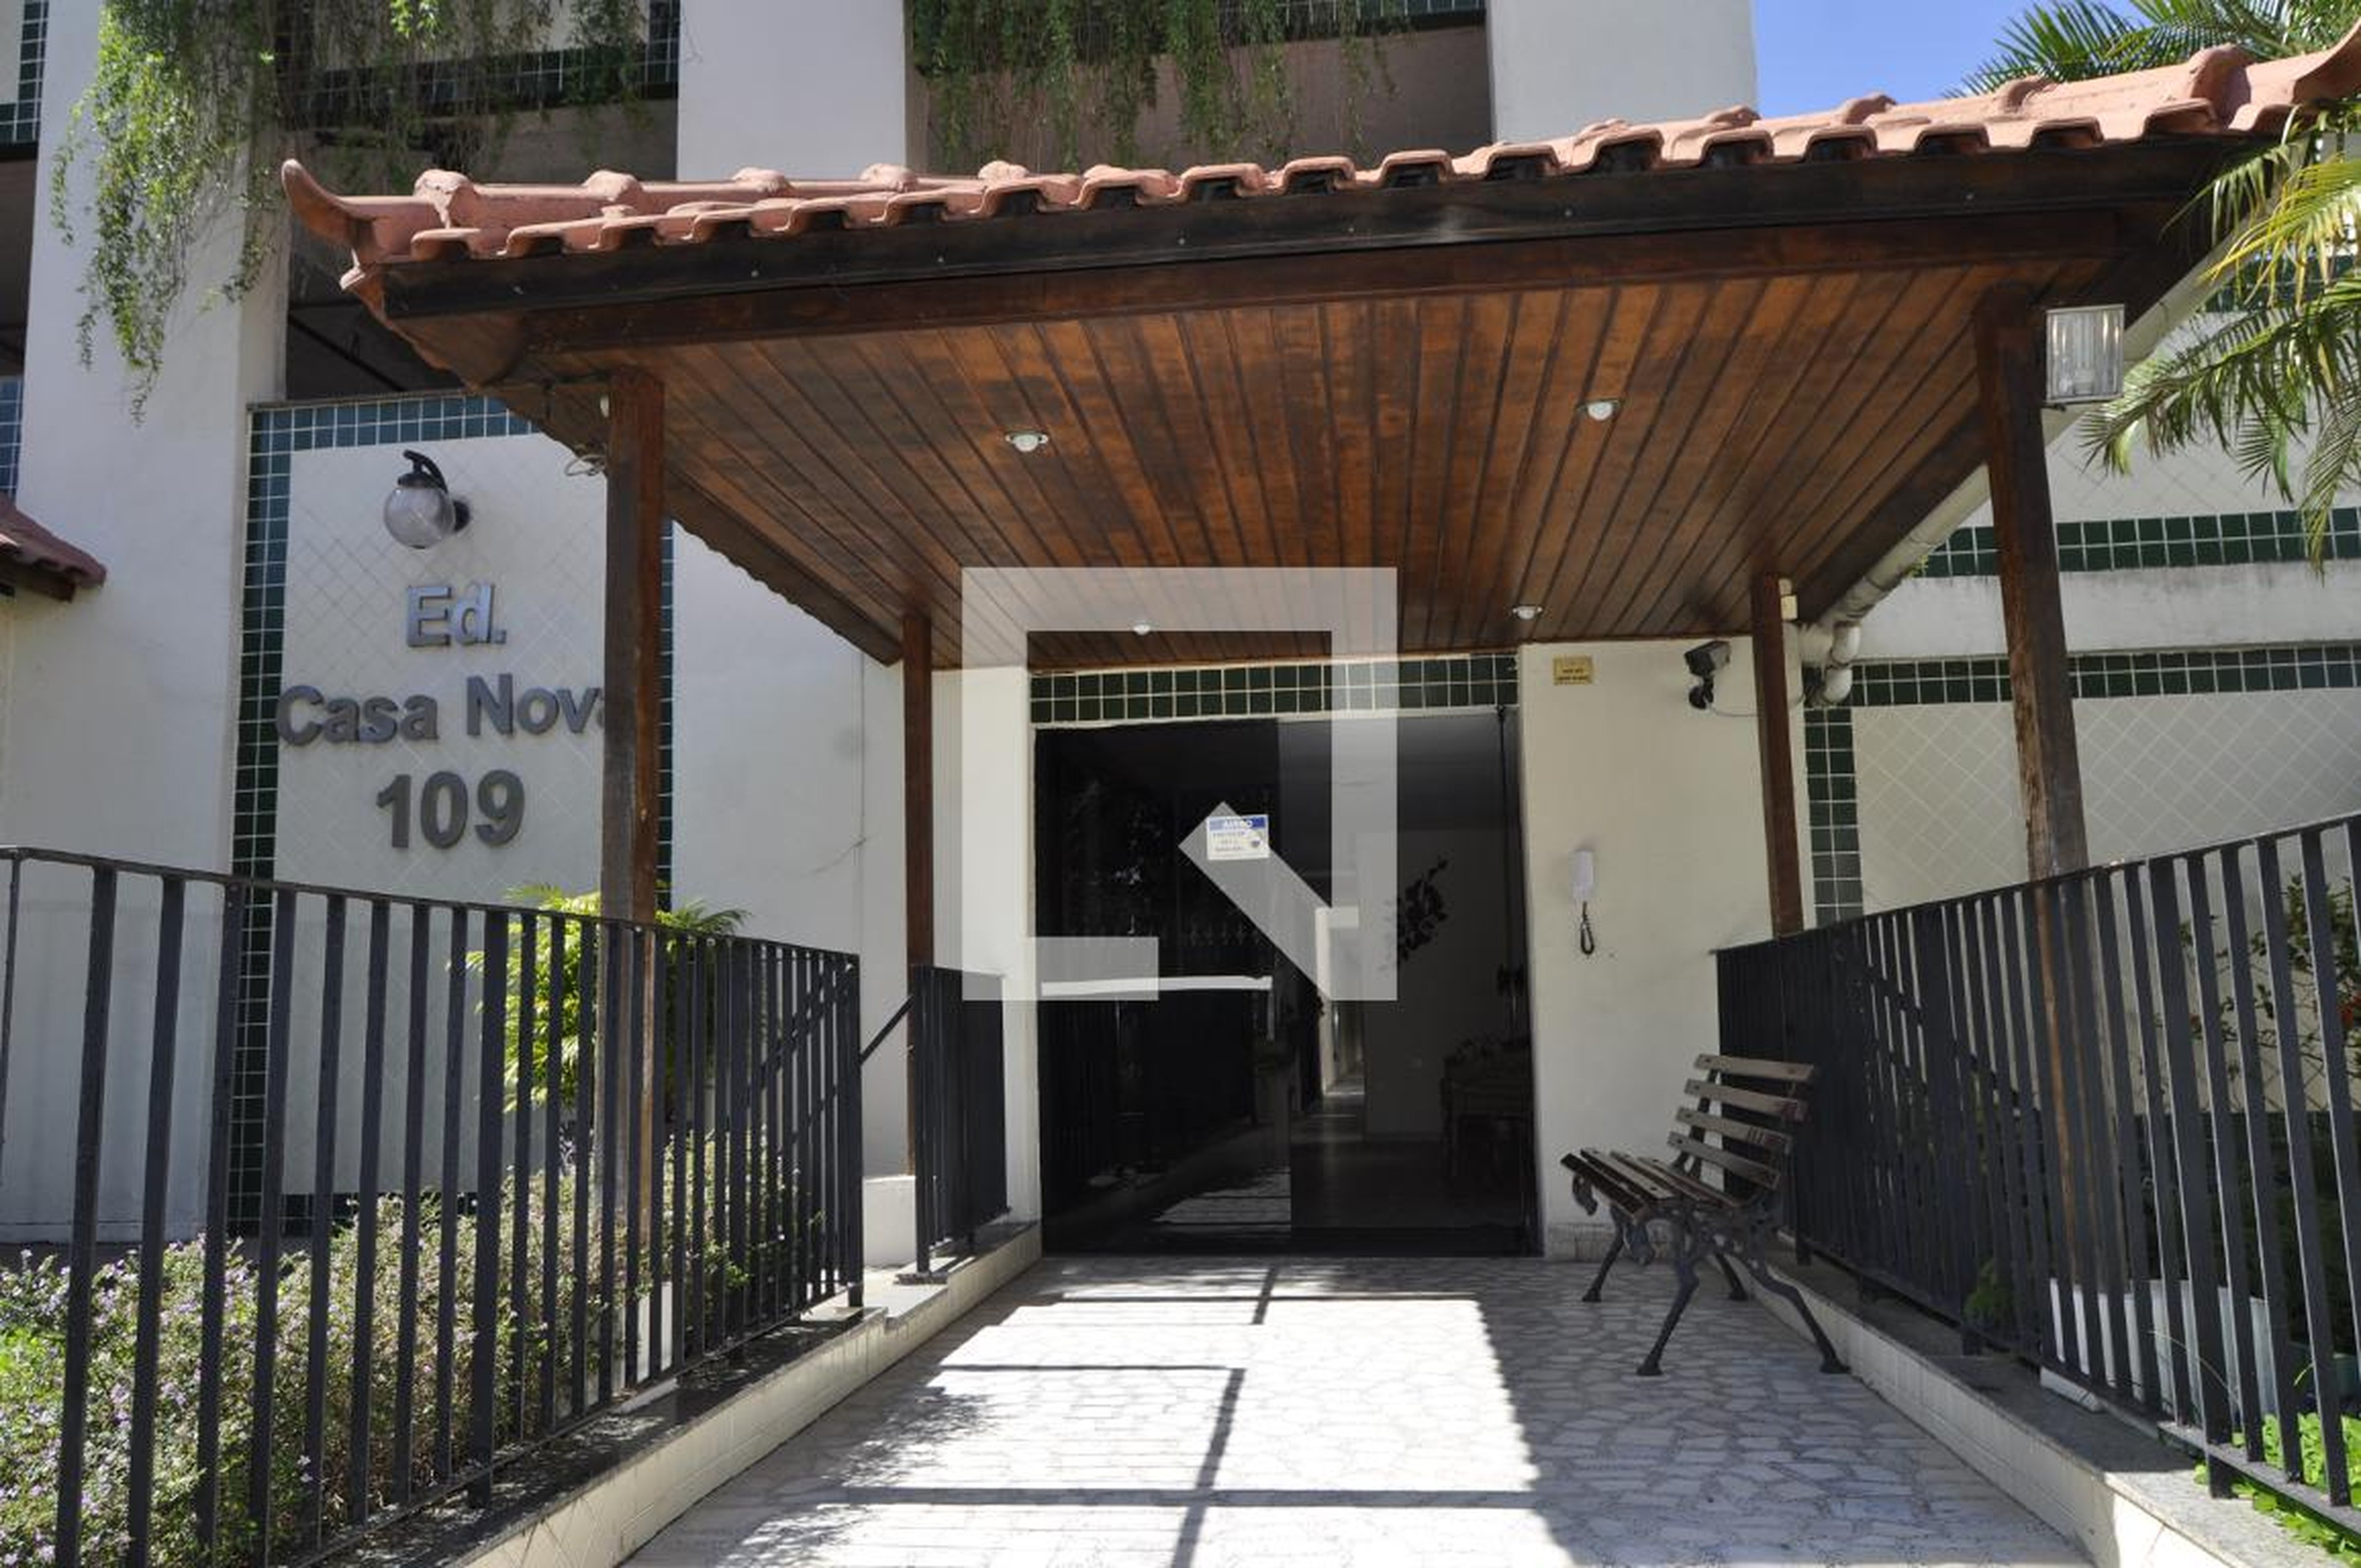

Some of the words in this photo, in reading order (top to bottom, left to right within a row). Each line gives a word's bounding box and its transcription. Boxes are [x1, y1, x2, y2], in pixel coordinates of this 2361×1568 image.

[406, 581, 507, 648] Ed.
[275, 684, 440, 746] Casa
[465, 673, 605, 736] Nov
[376, 770, 526, 849] 109
